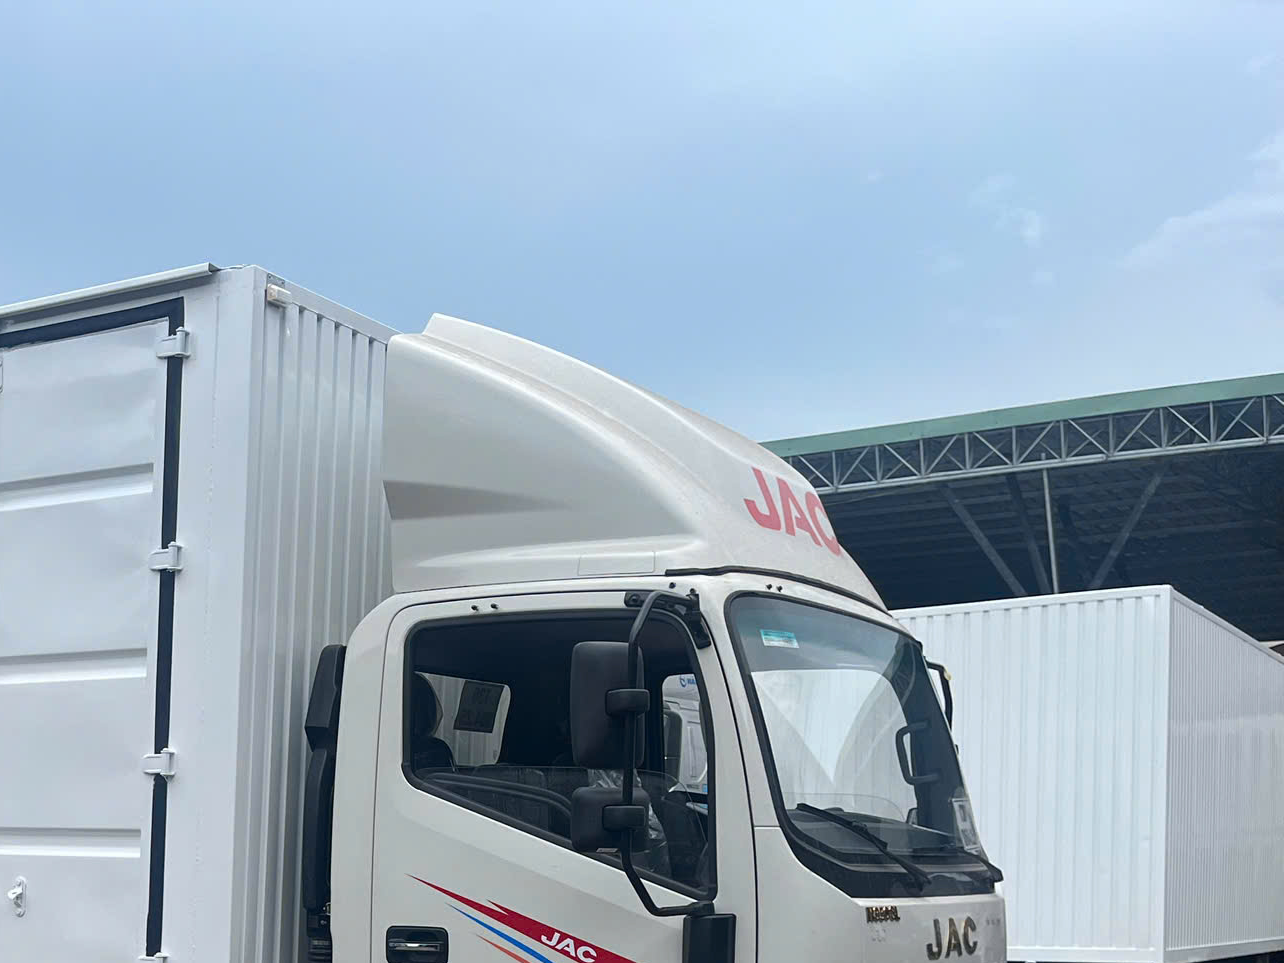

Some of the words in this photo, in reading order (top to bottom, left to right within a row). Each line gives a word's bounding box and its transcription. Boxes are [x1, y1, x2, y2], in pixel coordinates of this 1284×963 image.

[743, 466, 841, 557] JAC
[541, 932, 597, 963] JAC
[926, 916, 978, 961] JAC
